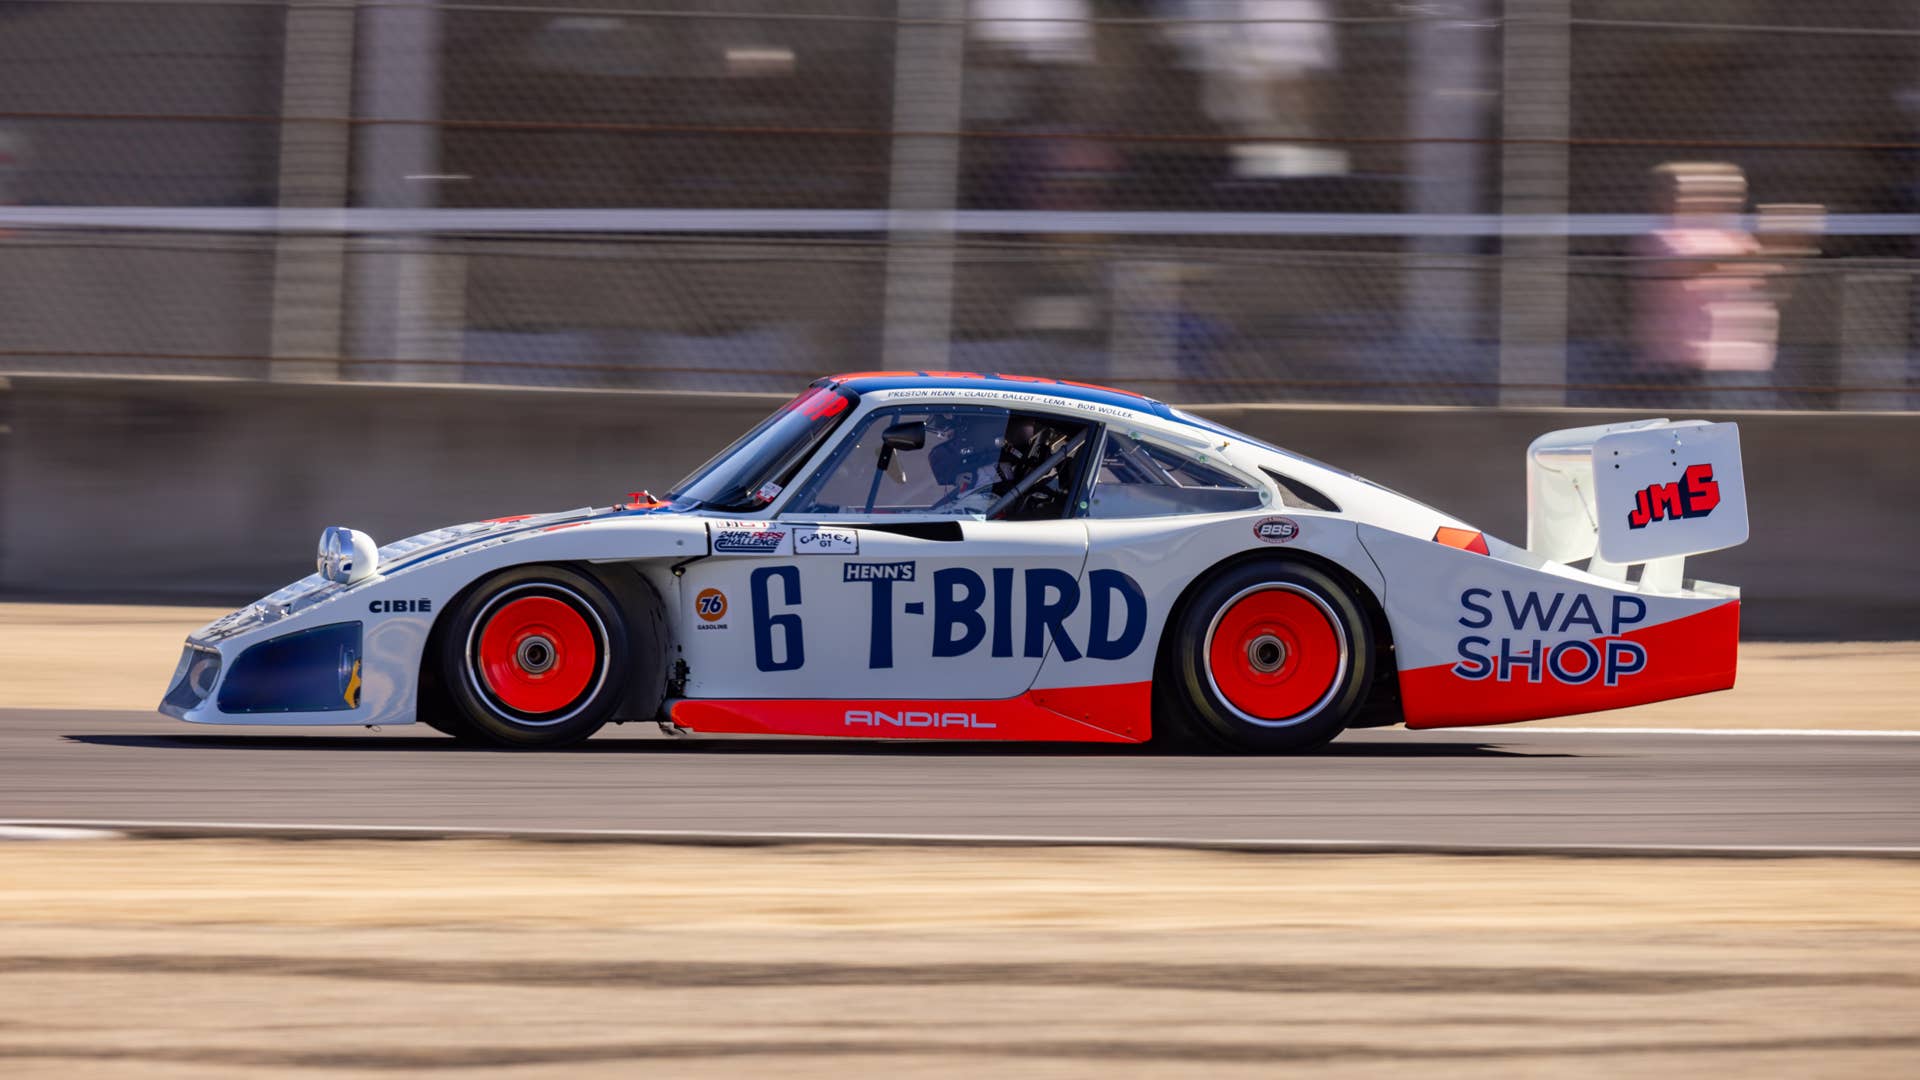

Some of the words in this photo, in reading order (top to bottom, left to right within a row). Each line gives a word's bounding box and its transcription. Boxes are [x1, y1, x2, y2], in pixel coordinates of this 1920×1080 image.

[1002, 393, 1034, 401] BALLOT
[1043, 398, 1065, 406] LENA
[1077, 403, 1095, 411] BOB
[1098, 407, 1135, 418] WOLLEK
[751, 531, 786, 539] PEPSI
[800, 533, 852, 544] CAMEL
[1260, 524, 1293, 535] BBS
[819, 540, 832, 548] GT
[846, 563, 913, 580] HENN'S
[701, 595, 722, 613] 76
[1458, 588, 1647, 635] SWAP
[750, 565, 805, 672] 6
[843, 561, 1148, 669] T-BIRD
[1452, 636, 1647, 686] SHOP
[845, 710, 997, 729] ANDIAL
